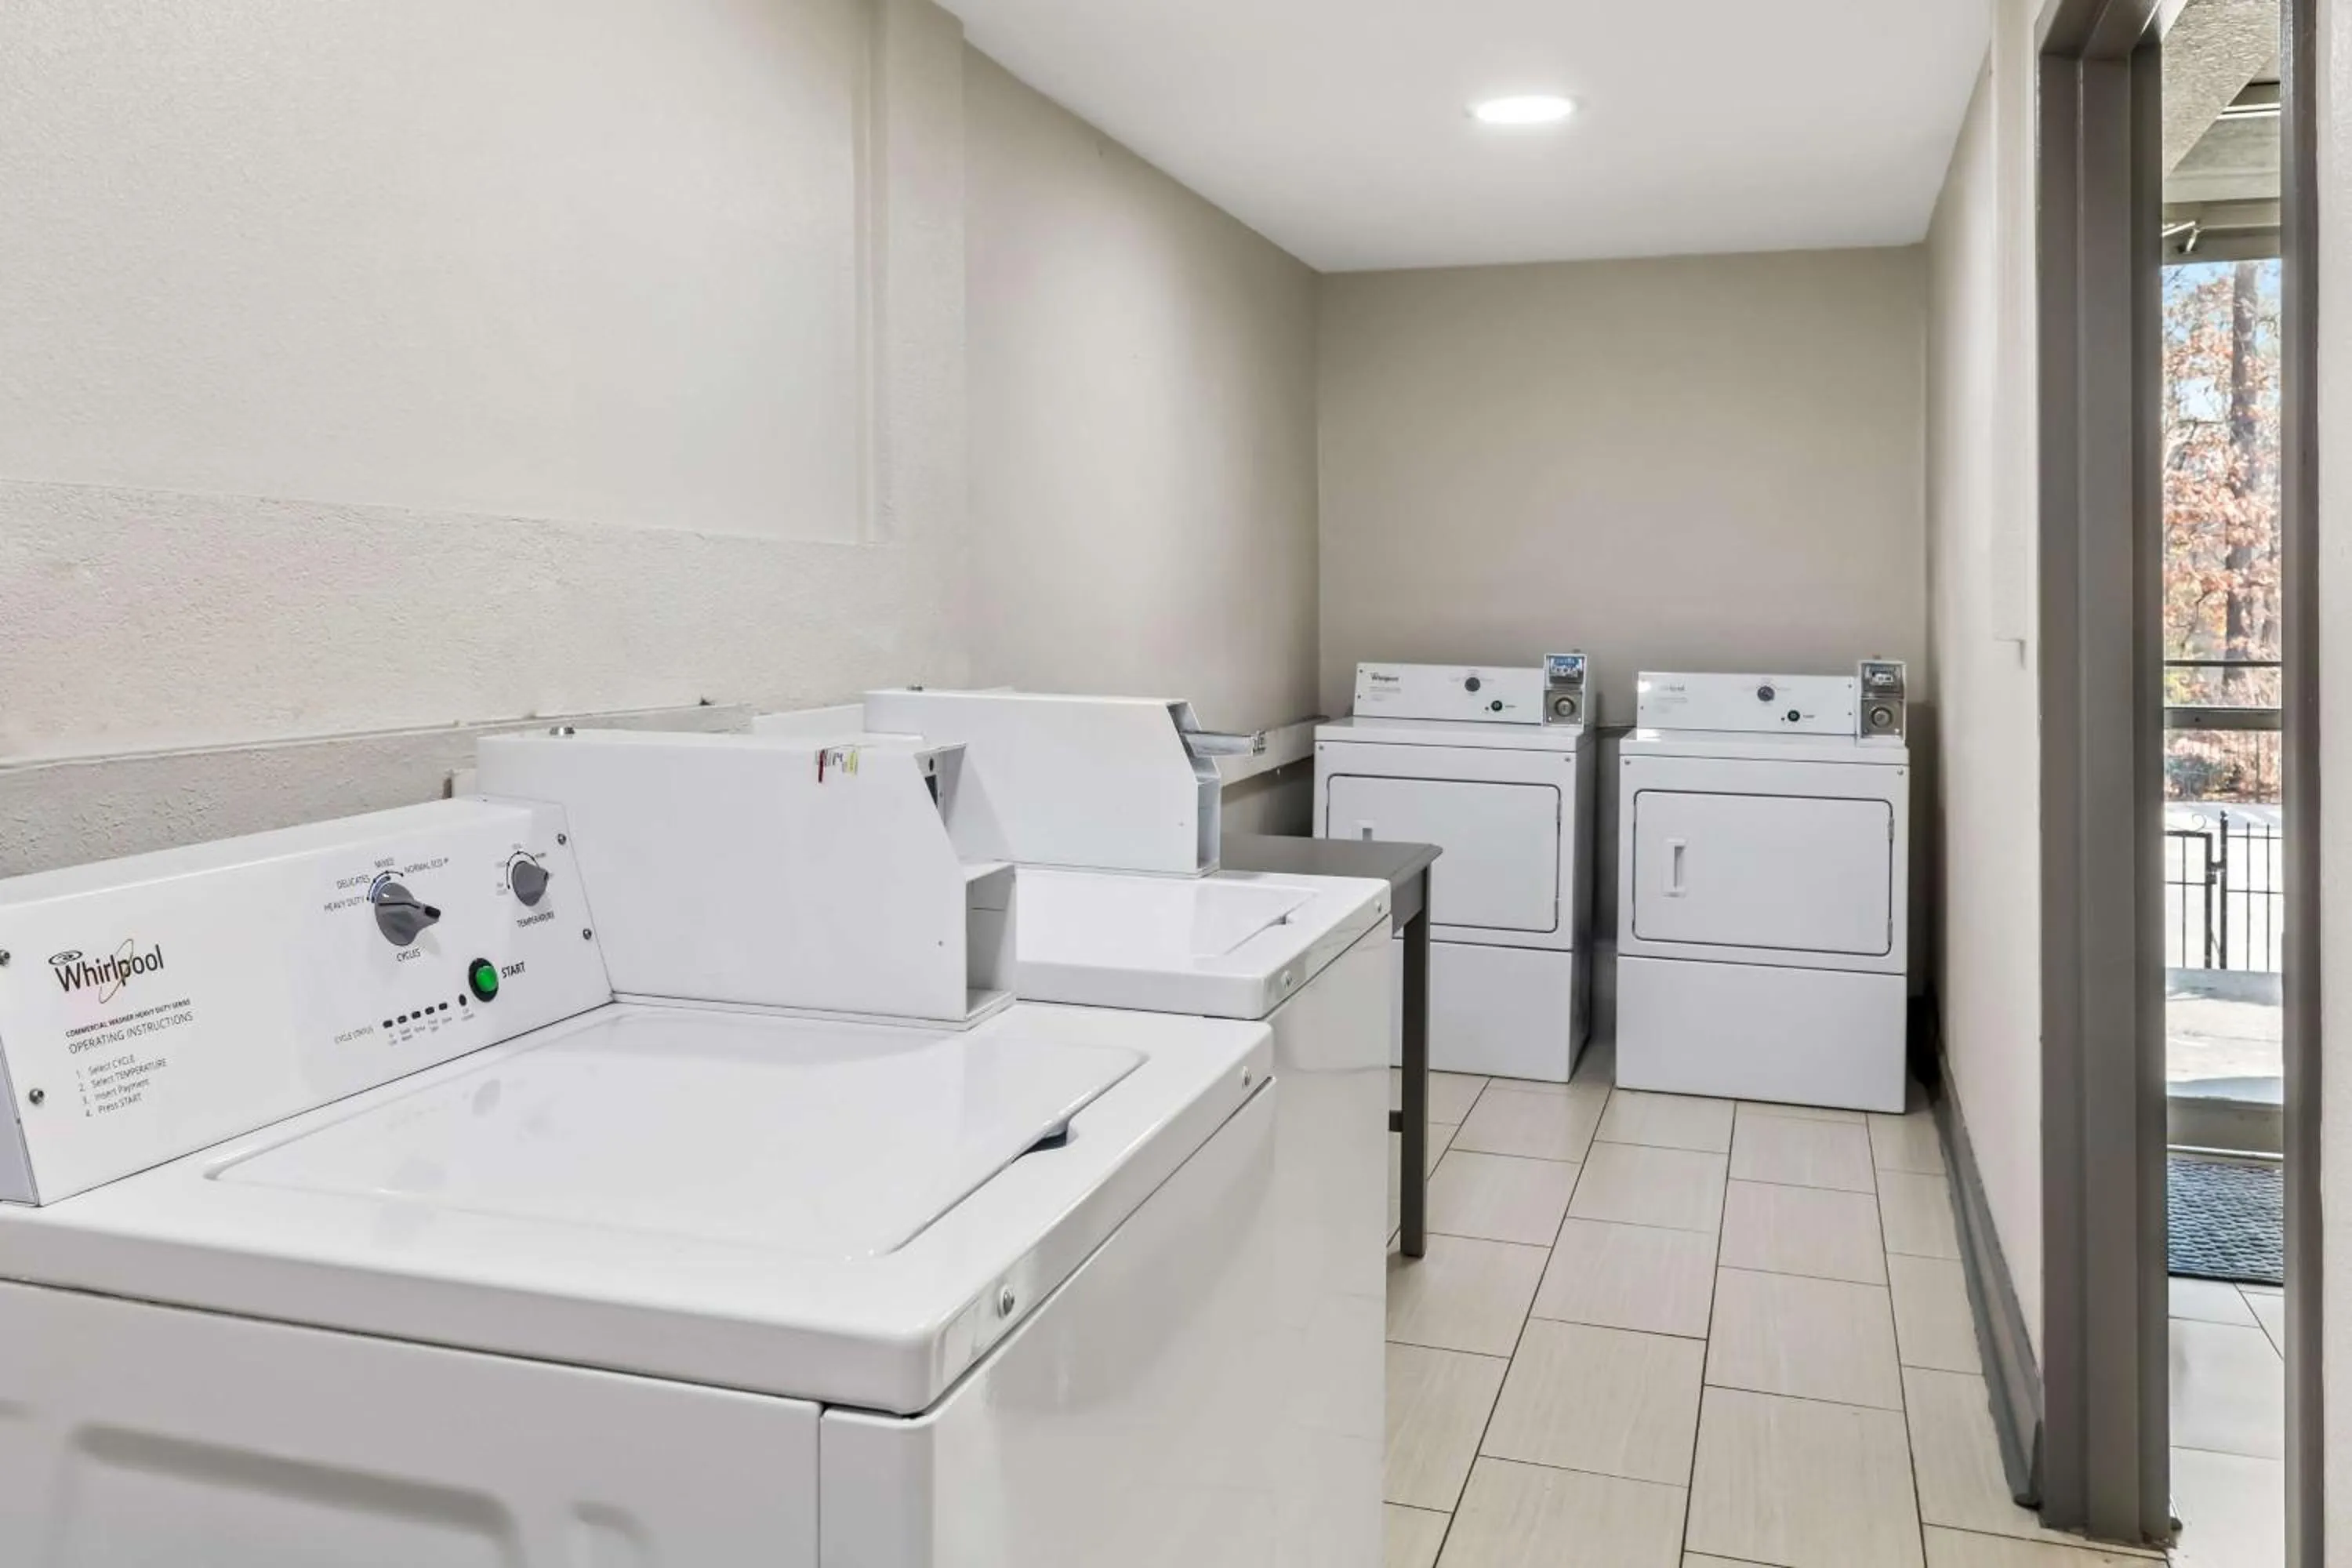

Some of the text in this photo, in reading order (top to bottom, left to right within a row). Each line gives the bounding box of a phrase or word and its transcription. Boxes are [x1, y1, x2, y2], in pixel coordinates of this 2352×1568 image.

[336, 875, 372, 890] DELICATES
[324, 896, 365, 912] HEAVY DUTY
[396, 948, 422, 963] CYCLES
[55, 943, 165, 993] Whirlpool
[501, 961, 526, 979] START
[65, 1022, 107, 1038] COMMERCIAL
[108, 1014, 134, 1026] WASHER
[68, 1011, 194, 1054] OPERATING INSTRUCTIONS
[88, 1063, 111, 1076] Select
[111, 1054, 136, 1069] CYCLE
[91, 1075, 114, 1089] Select
[114, 1058, 167, 1080] TEMPERATURE
[98, 1101, 119, 1114] Press
[119, 1092, 142, 1108] START
